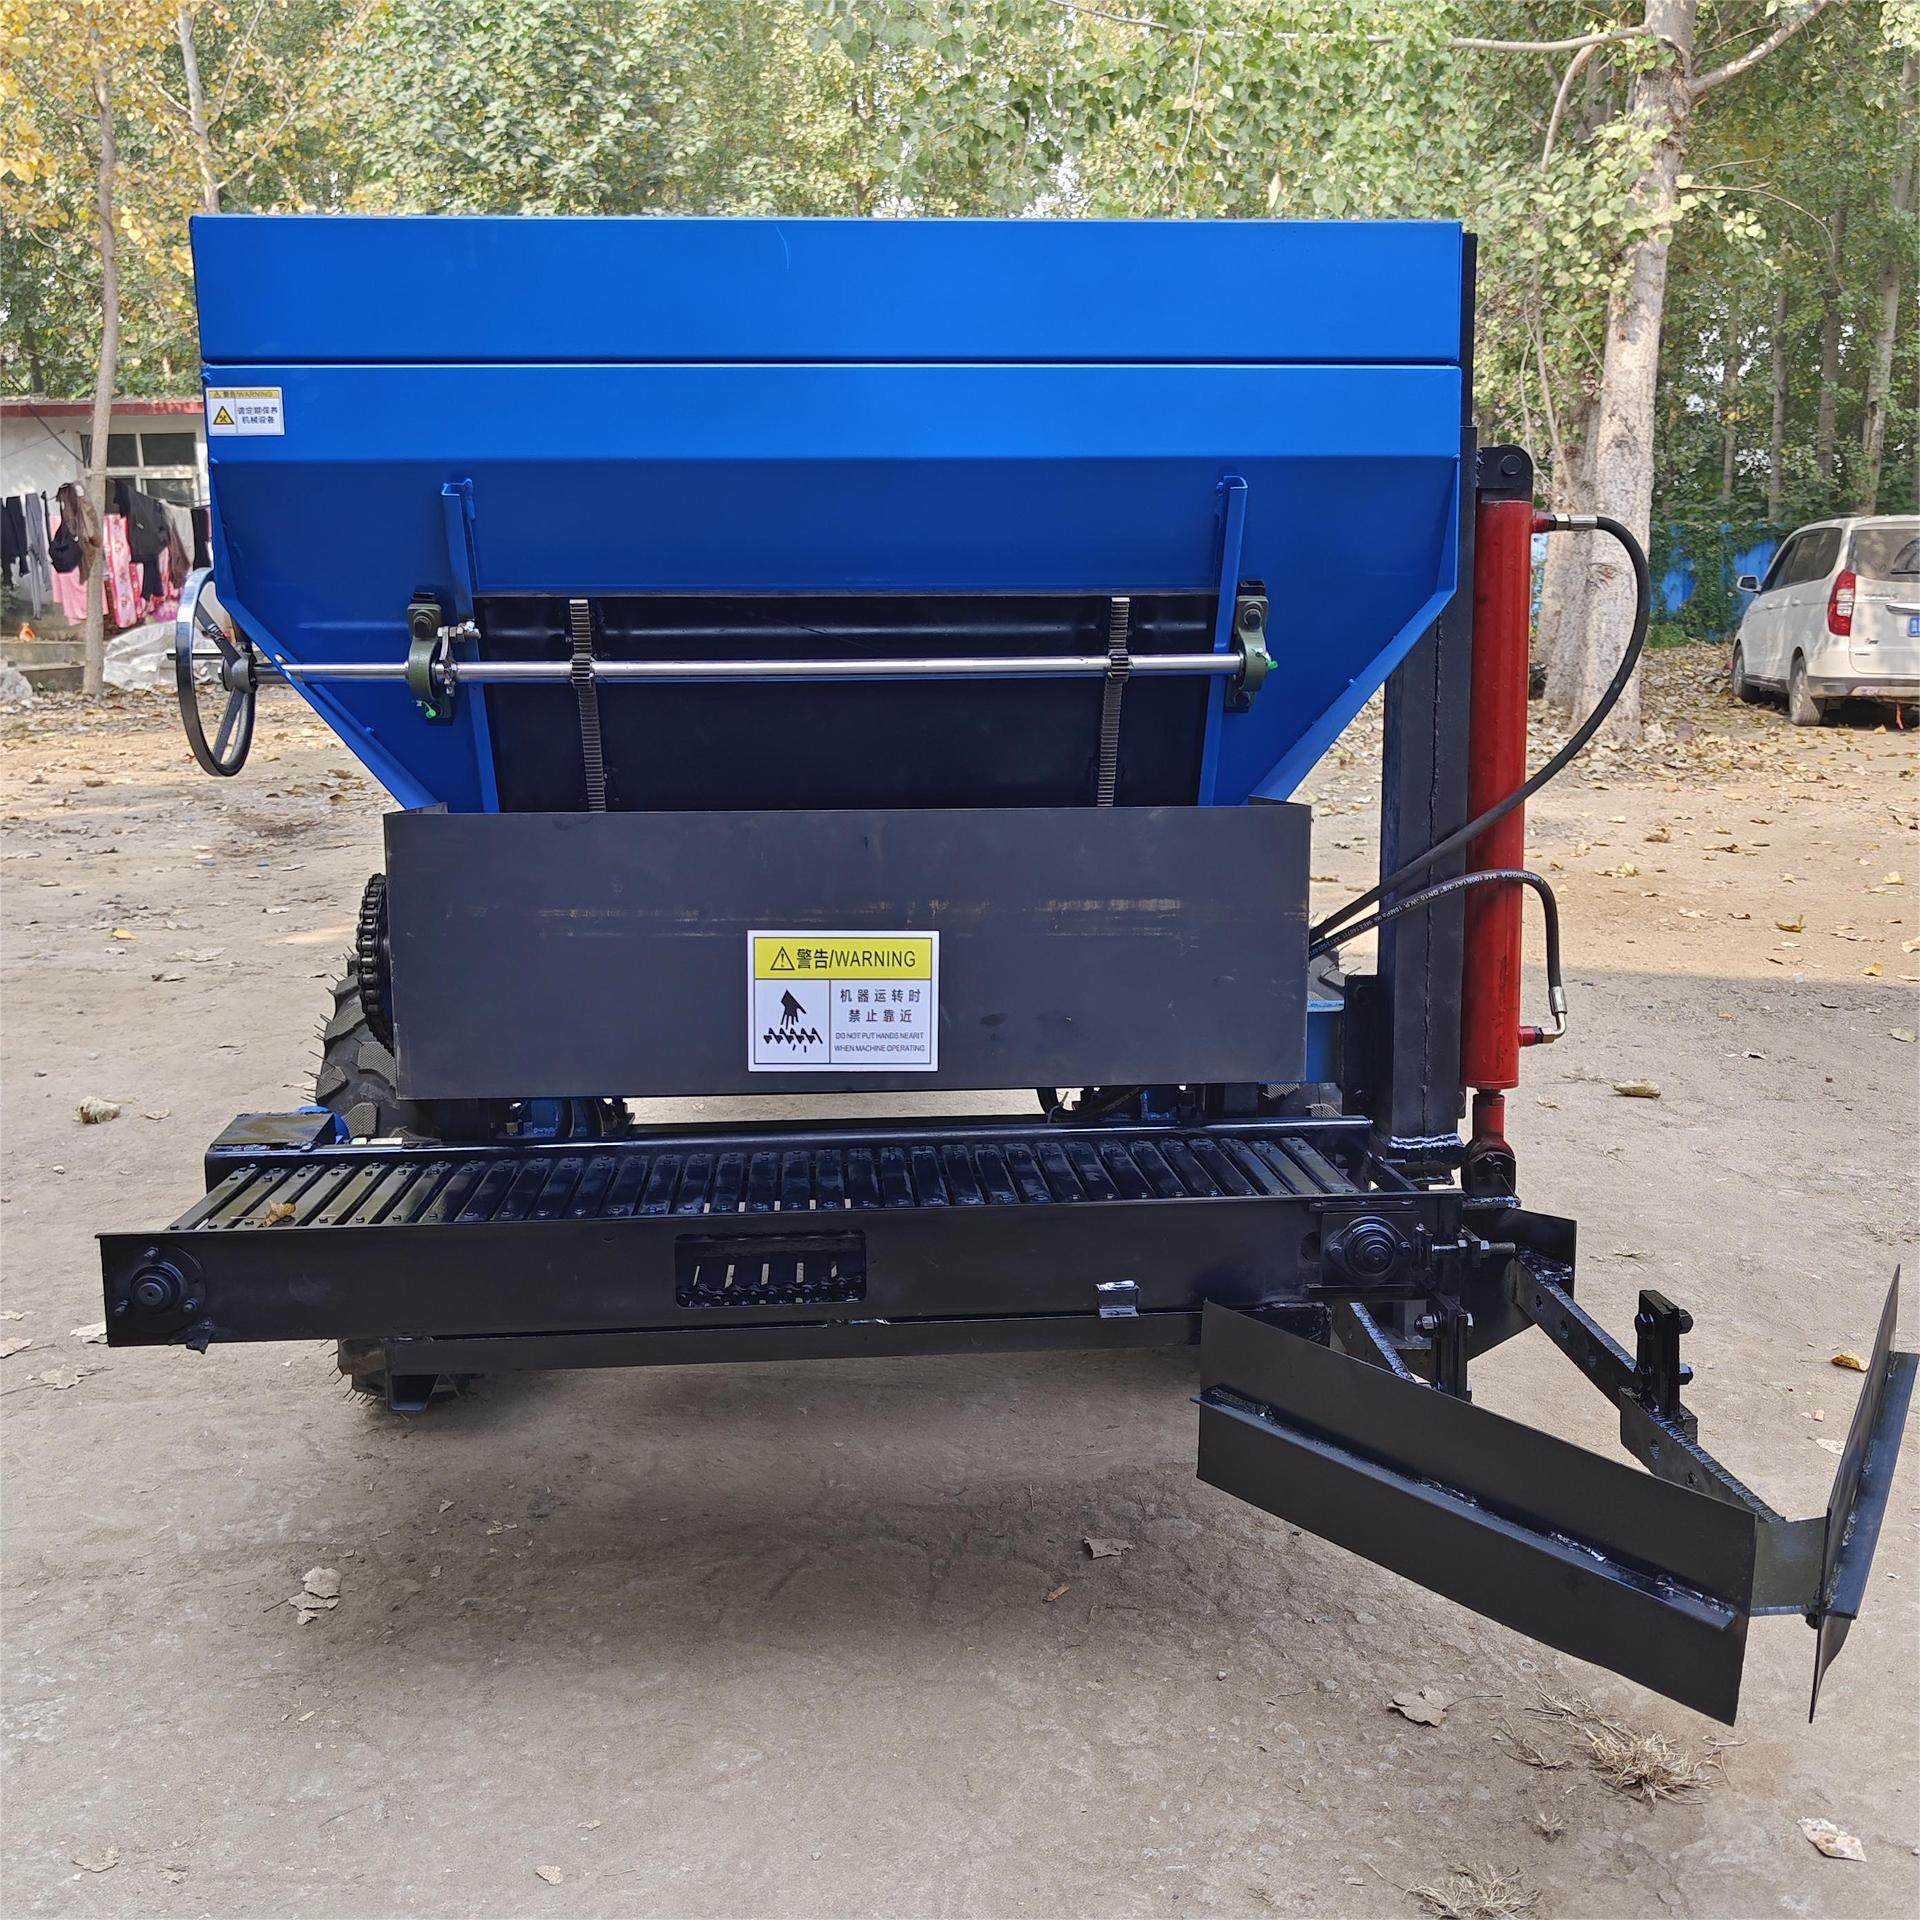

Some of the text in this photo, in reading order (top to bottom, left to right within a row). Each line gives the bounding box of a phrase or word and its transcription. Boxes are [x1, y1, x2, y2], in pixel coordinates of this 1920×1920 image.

[242, 416, 274, 424] 机械设备
[797, 948, 916, 969] 警告/WARNING
[840, 988, 921, 1003] 机器运转时
[848, 1009, 912, 1023] 禁止靠近
[836, 1032, 845, 1040] DO
[846, 1032, 860, 1040] NOT
[862, 1032, 875, 1040] PUT
[876, 1032, 898, 1040] HANDS
[834, 1044, 925, 1052] WHEN MACHINE OPERATING
